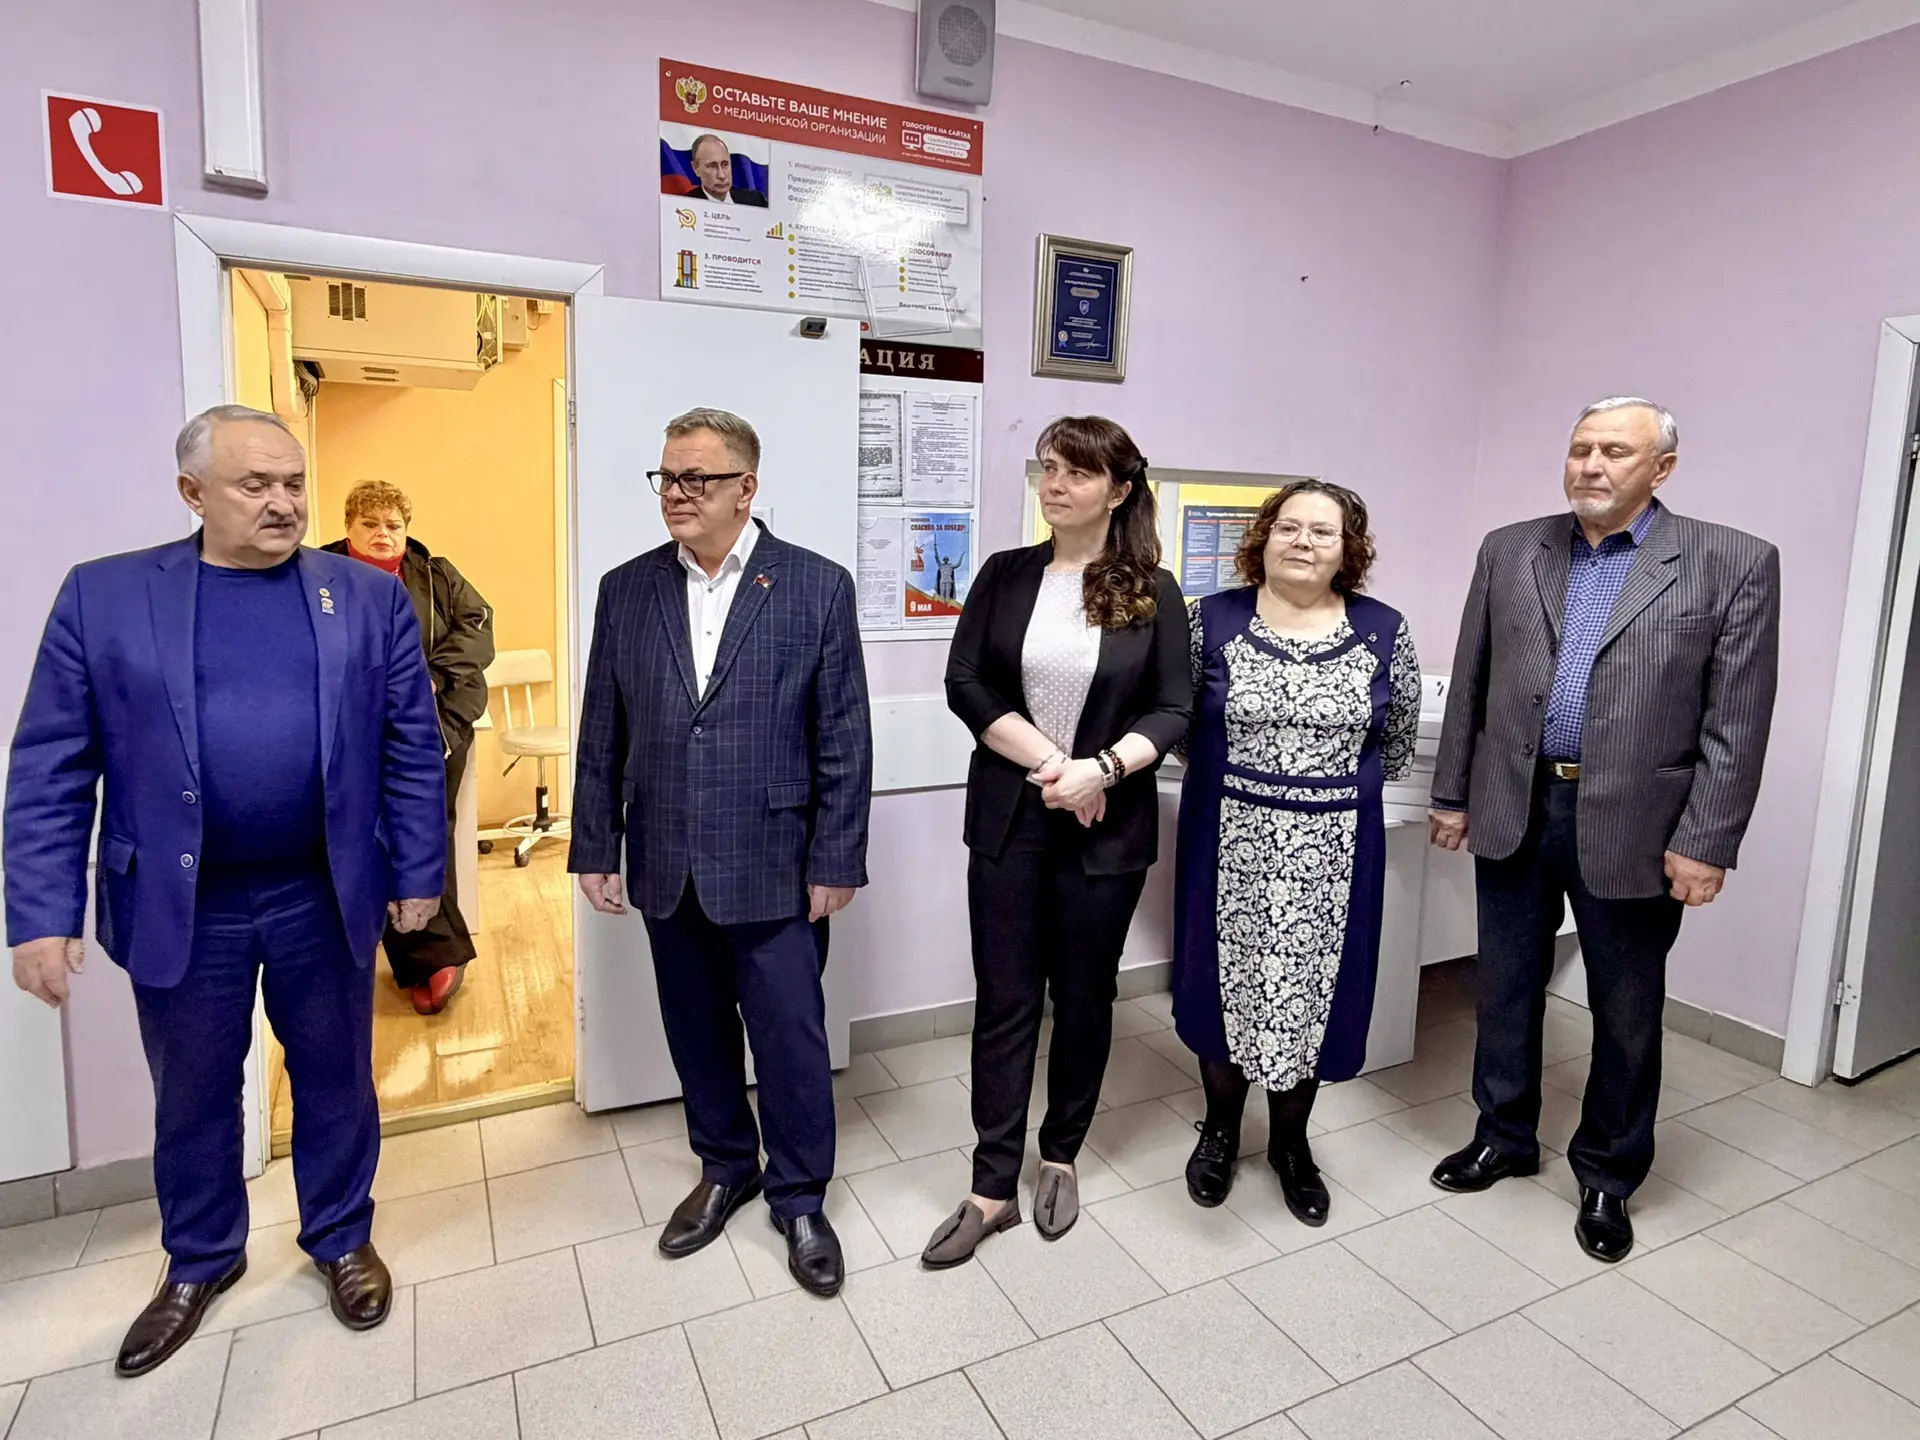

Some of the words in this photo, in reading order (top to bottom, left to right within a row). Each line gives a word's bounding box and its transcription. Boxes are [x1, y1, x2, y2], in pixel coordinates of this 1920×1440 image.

[712, 85, 786, 110] ОСТАВЬТЕ
[789, 100, 830, 119] ВАШЕ
[833, 108, 888, 129] МНЕНИЕ
[712, 104, 721, 114] О
[724, 106, 808, 130] МЕДИЦИНСКОЙ
[810, 122, 887, 144] ОРГАНИЗАЦИИ
[902, 120, 938, 133] ГОЛОСУЙТЕ
[948, 129, 972, 140] САЙТАХ
[788, 174, 834, 187] Президент
[711, 212, 731, 221] ЦЕЛЬ
[904, 246, 952, 258] ОЛОСОВАНИЯ
[712, 253, 762, 266] ПРОВОДИТСЯ
[910, 601, 916, 612] 9
[917, 603, 932, 612] МАЯ
